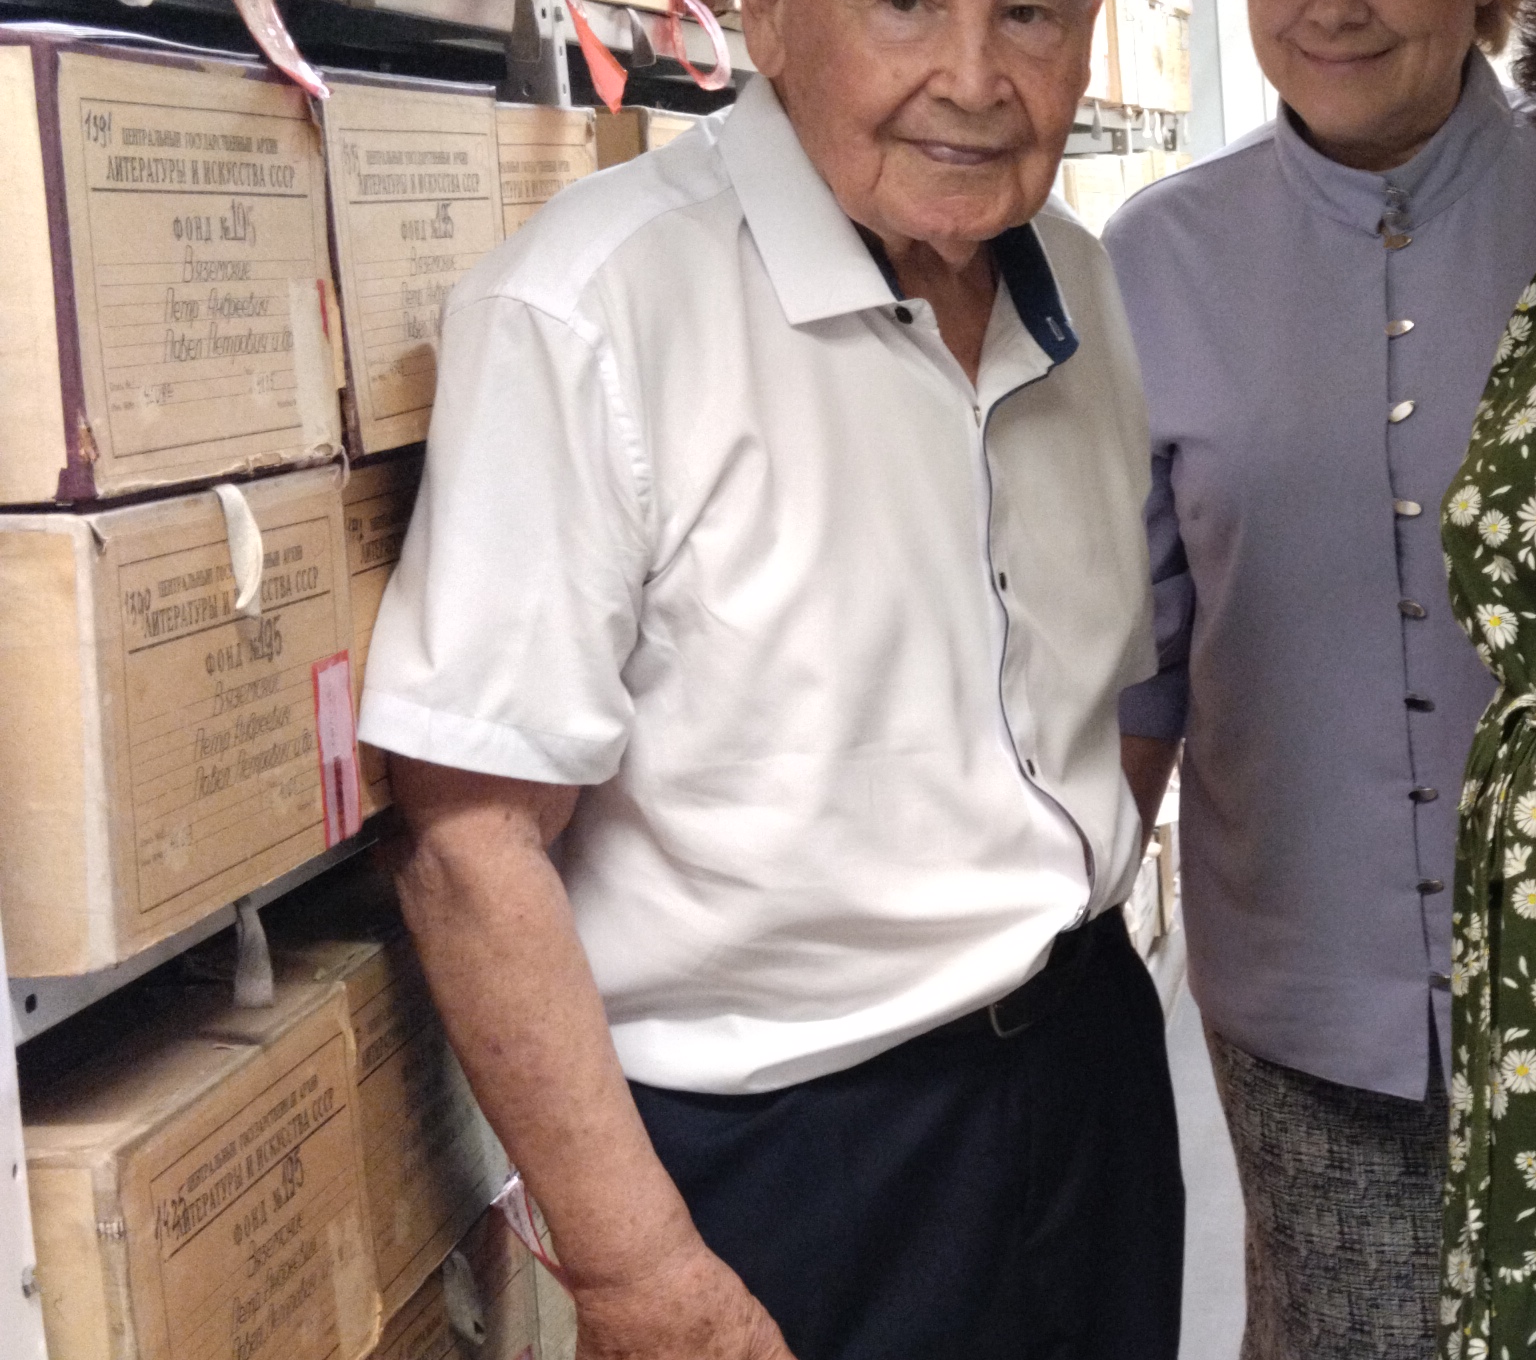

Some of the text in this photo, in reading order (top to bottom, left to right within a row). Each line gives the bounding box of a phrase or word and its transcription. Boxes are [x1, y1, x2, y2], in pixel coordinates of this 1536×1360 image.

[106, 155, 296, 189] ЛИТЕРАТУРЫ И ИСКУССТВА СССР
[173, 216, 212, 241] ФОНД
[144, 595, 218, 639] ЛИТЕРАТУРЫ
[222, 591, 231, 616] И
[295, 566, 319, 592] СССР
[205, 643, 243, 676] ФОНД
